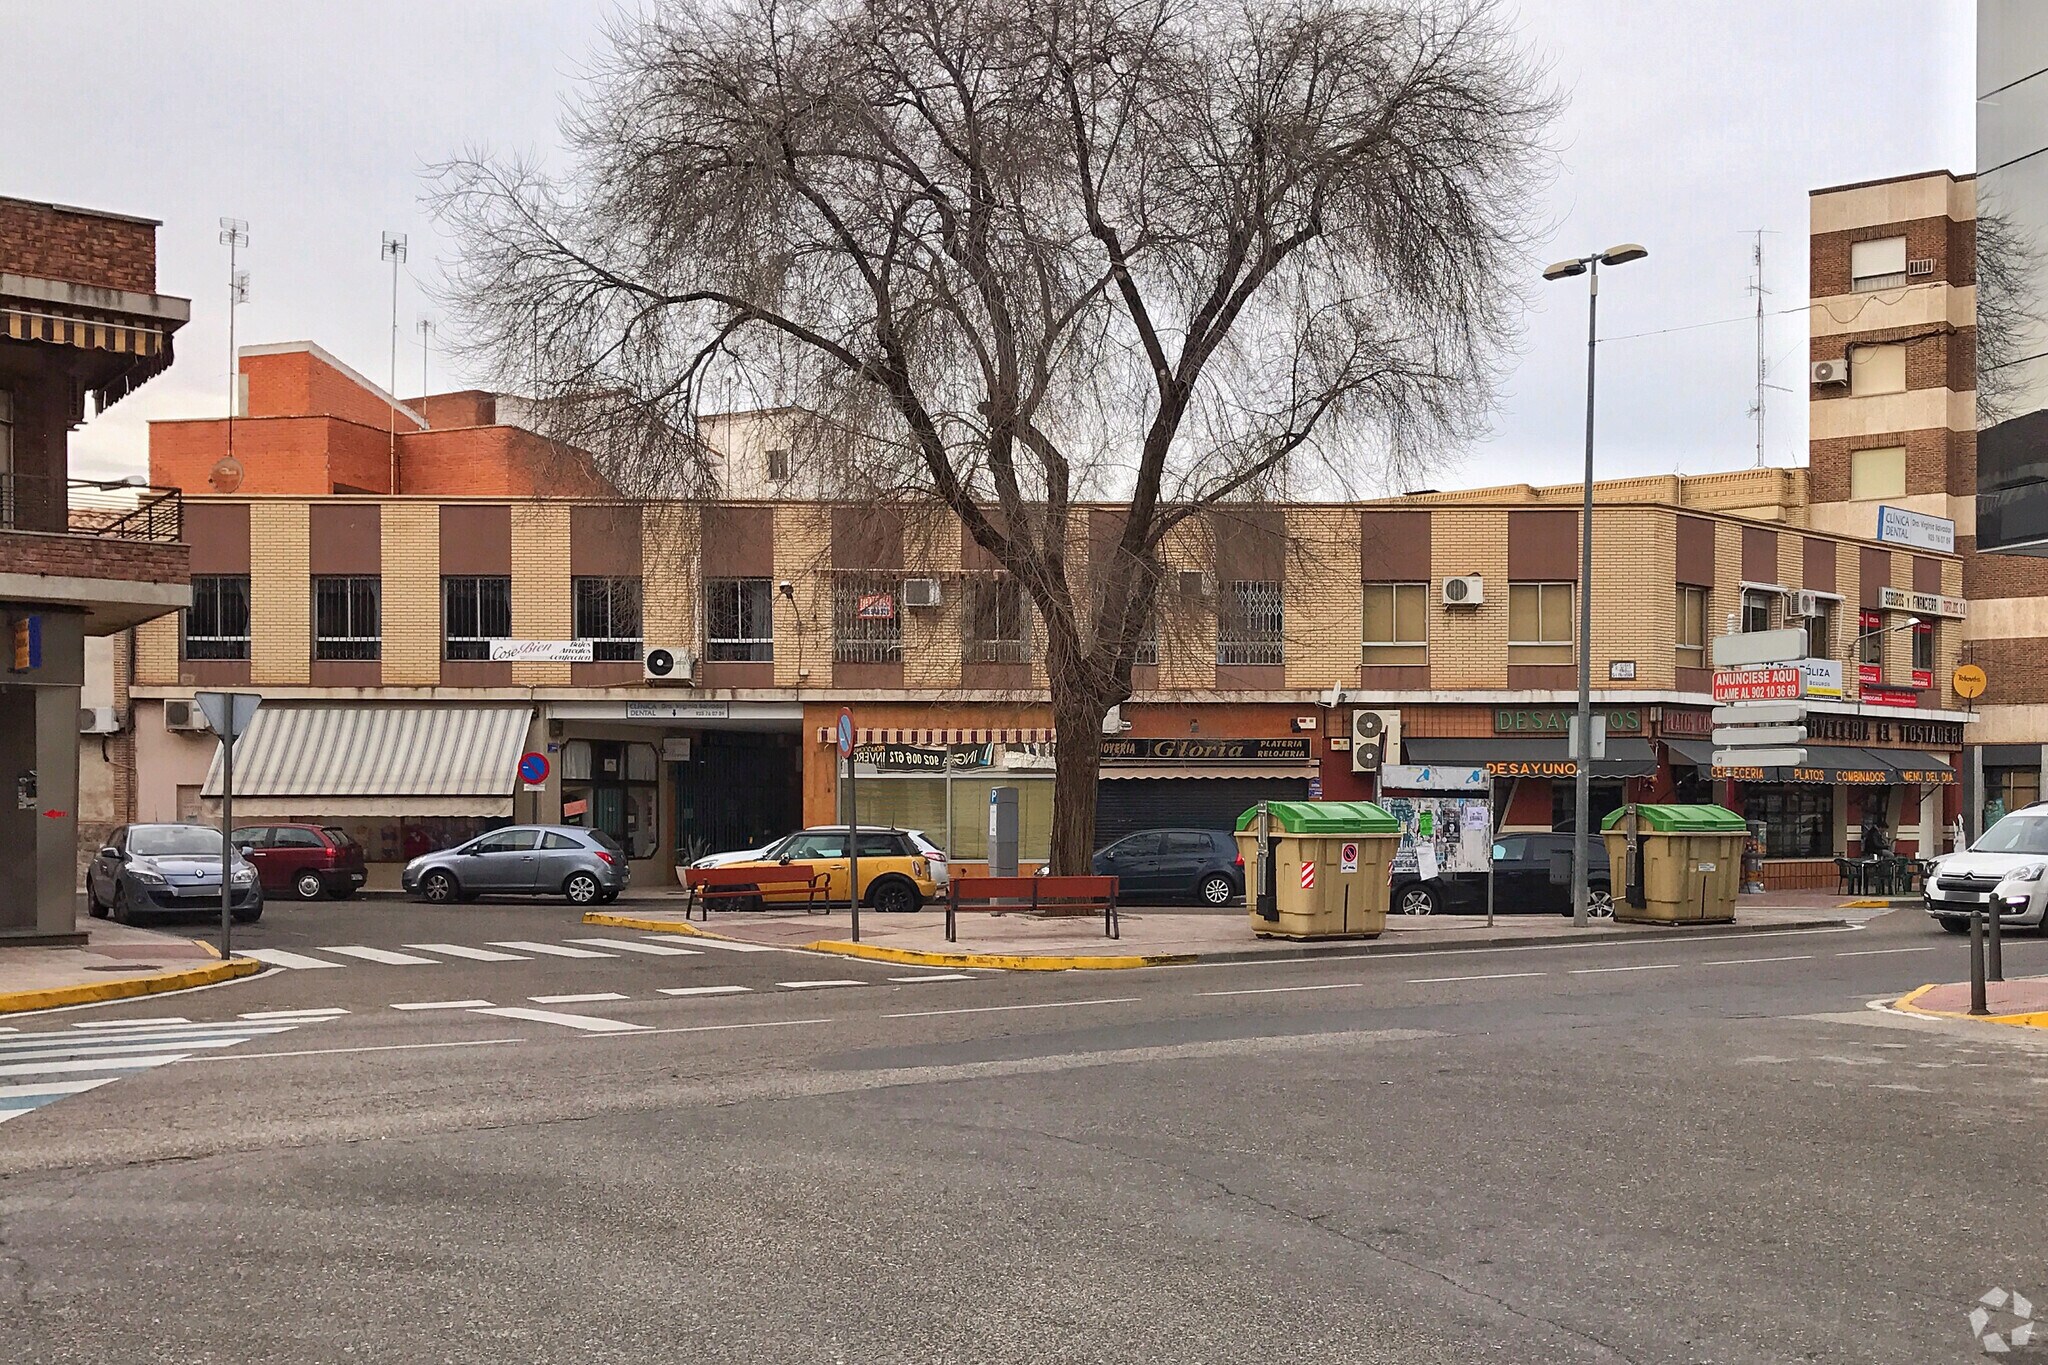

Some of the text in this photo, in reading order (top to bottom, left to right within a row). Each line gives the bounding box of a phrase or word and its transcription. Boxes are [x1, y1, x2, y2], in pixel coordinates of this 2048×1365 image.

[1886, 526, 1908, 539] DENTAL
[492, 642, 552, 660] Cose Bien
[1716, 669, 1796, 686] ANUNCIESE AQUI
[1716, 685, 1796, 700] LLAME AL 902 10 36 69
[1499, 711, 1640, 730] DESAYOS
[1902, 723, 1963, 744] TOSTADERO
[1154, 740, 1244, 758] Gloria
[1260, 740, 1303, 748] PLATERIA
[1257, 750, 1305, 758] RELOJERIA
[1486, 763, 1577, 774] DESAYUNO
[1711, 766, 1765, 779] CERECERIA
[1794, 768, 1886, 782] PLATOS COMBINADOS
[1925, 772, 1940, 782] DEL
[1942, 772, 1954, 782] DIA
[991, 789, 998, 803] P
